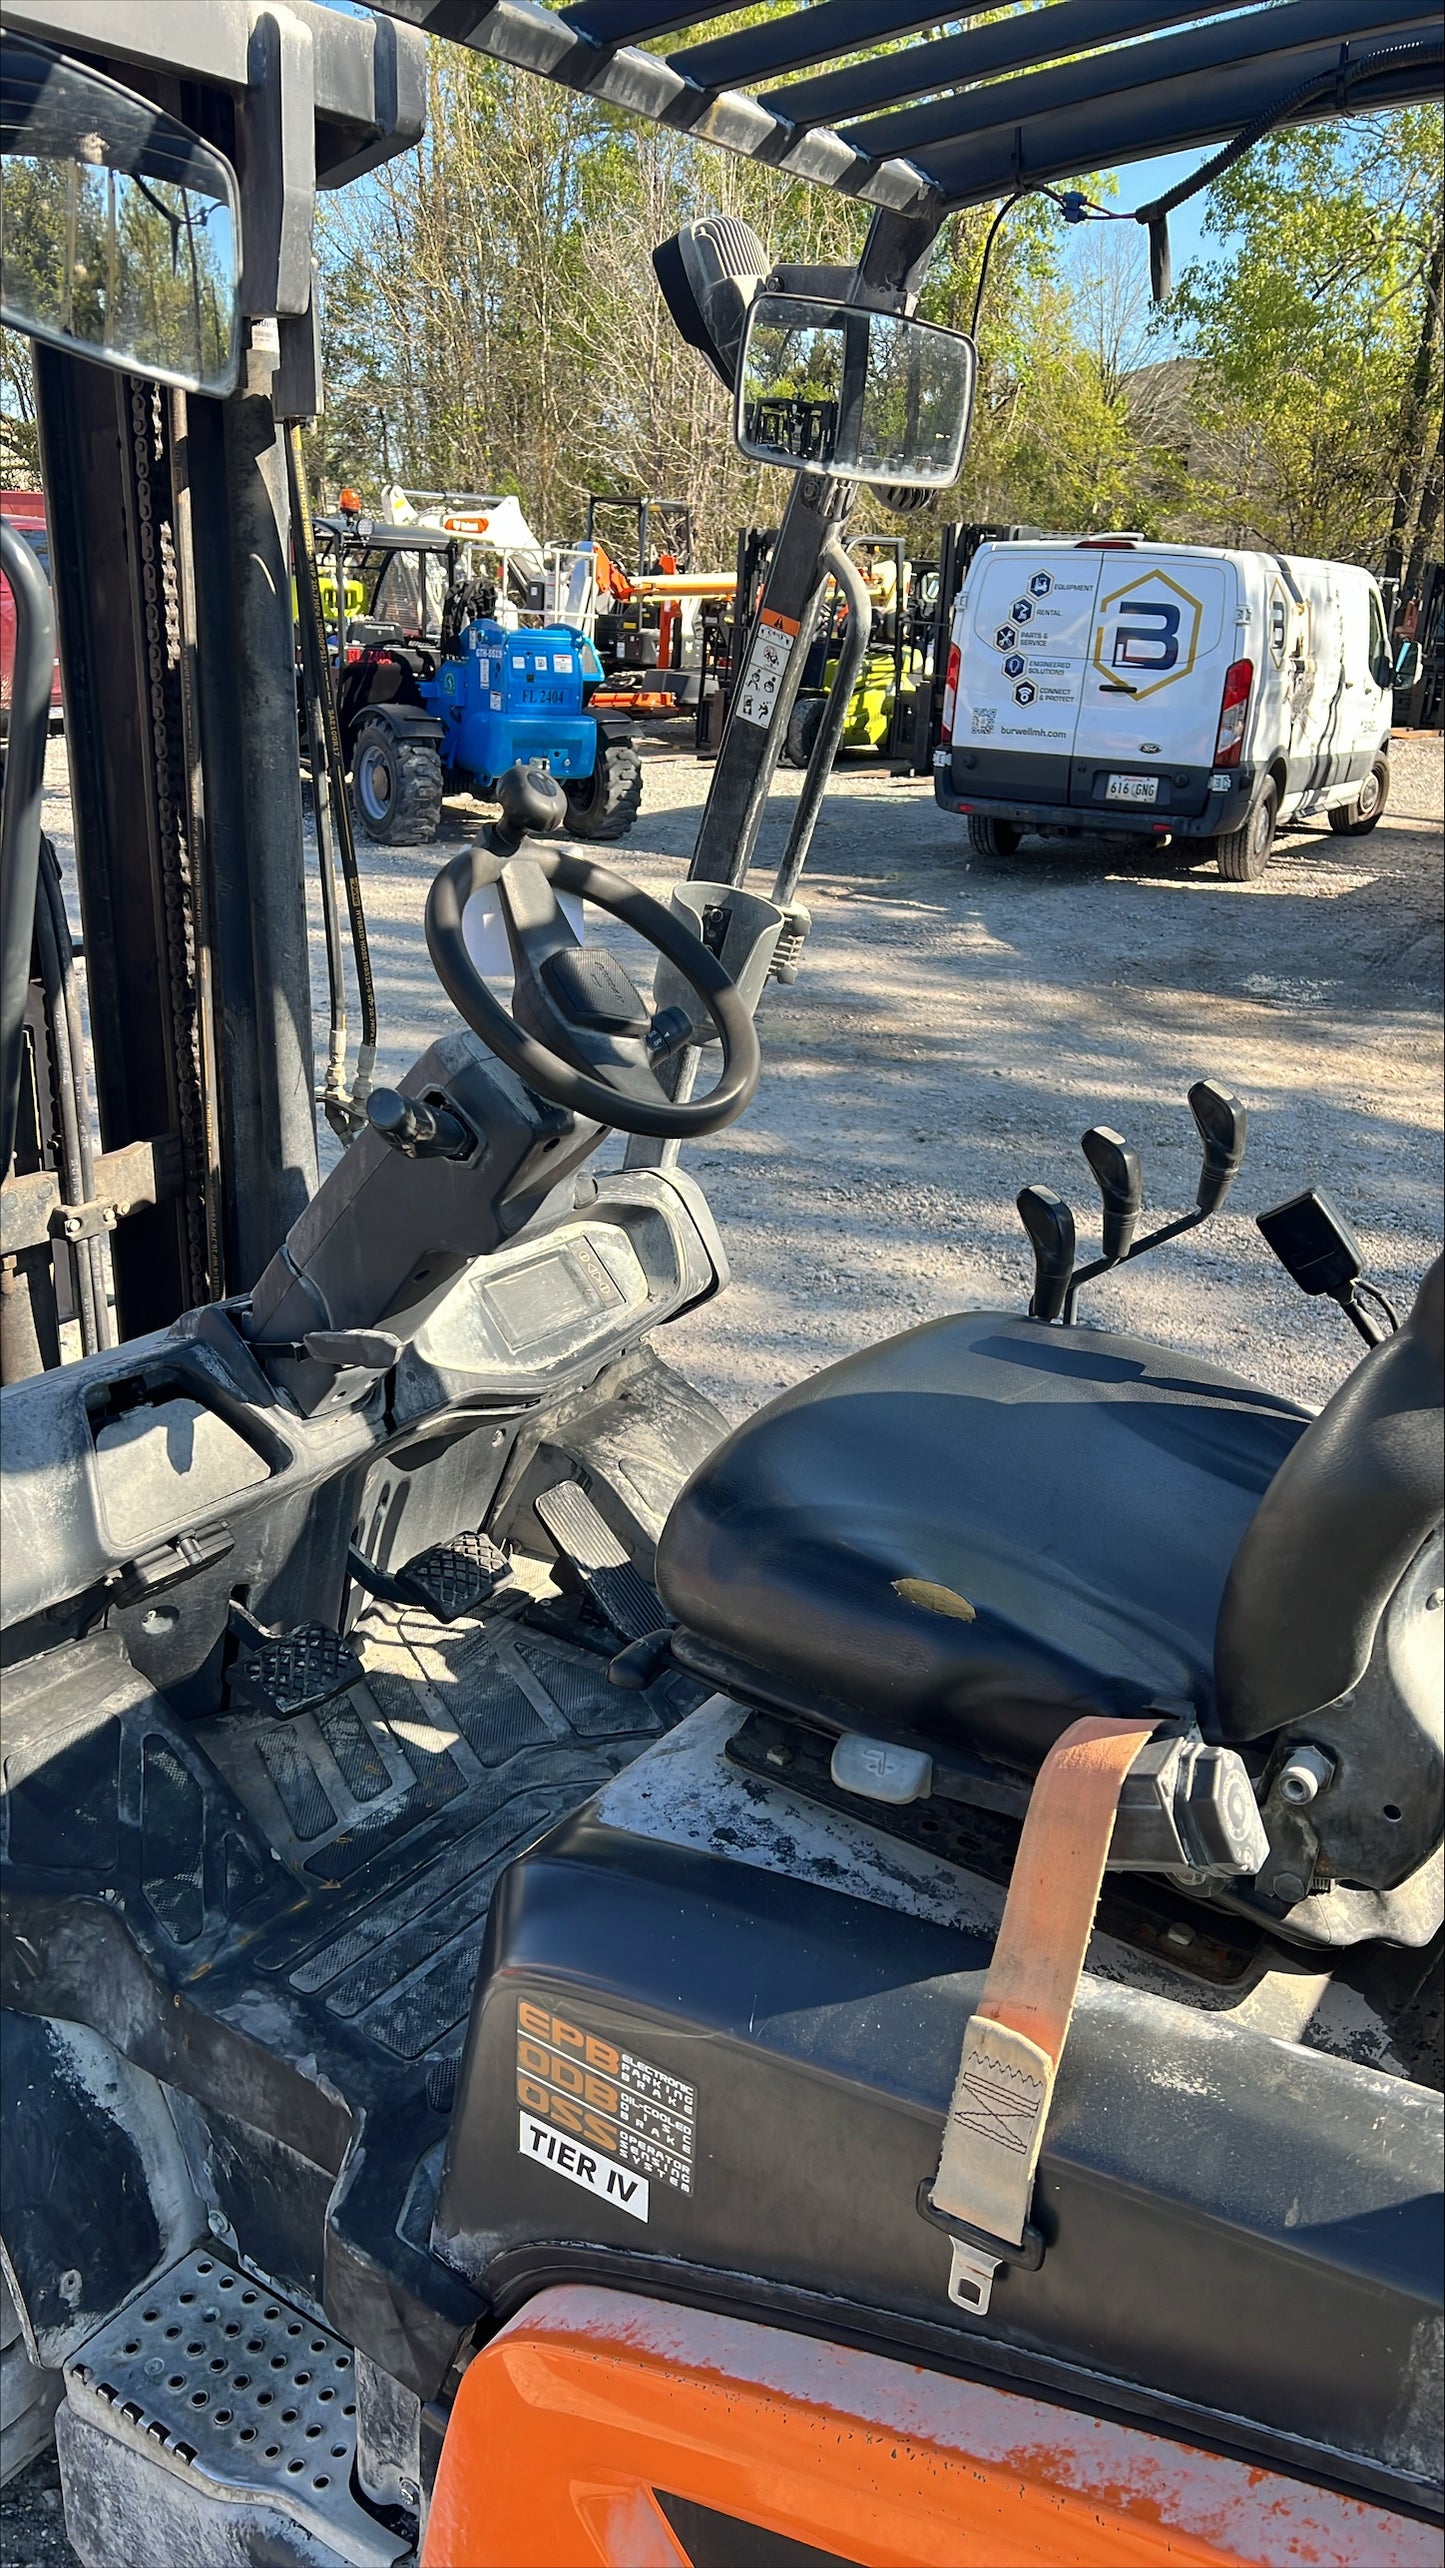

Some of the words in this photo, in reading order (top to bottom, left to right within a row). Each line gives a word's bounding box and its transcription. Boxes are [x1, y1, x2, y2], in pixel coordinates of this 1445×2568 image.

[300, 494, 310, 519] HOSE
[309, 562, 317, 577] WP
[317, 620, 328, 664] (3000PSI)
[1112, 601, 1180, 670] B
[1028, 668, 1065, 676] SOLUTIONS
[1029, 661, 1071, 669] ENGINEERED
[523, 690, 537, 703] FL
[540, 690, 564, 704] 2404
[1040, 687, 1071, 695] CONNECT
[328, 708, 340, 758] SAE100R17
[1001, 726, 1067, 739] burwellmh.com
[1110, 782, 1129, 794] 616
[1136, 783, 1155, 796] GNG
[355, 909, 365, 940] HYBRID
[359, 941, 369, 960] HOSE
[519, 2002, 620, 2075] EPB
[518, 2040, 618, 2113] ODB
[621, 2054, 694, 2096] ELECTRONIC
[621, 2071, 693, 2115] BRAKE
[518, 2078, 618, 2151] OSS
[620, 2101, 692, 2145] DISC
[620, 2110, 691, 2155] BRAKE
[621, 2092, 692, 2136] OIL-COOLED
[529, 2124, 598, 2184] TIER
[606, 2168, 639, 2203] IV
[619, 2148, 690, 2193] SYSTEM
[620, 2130, 691, 2175] OPERATOR
